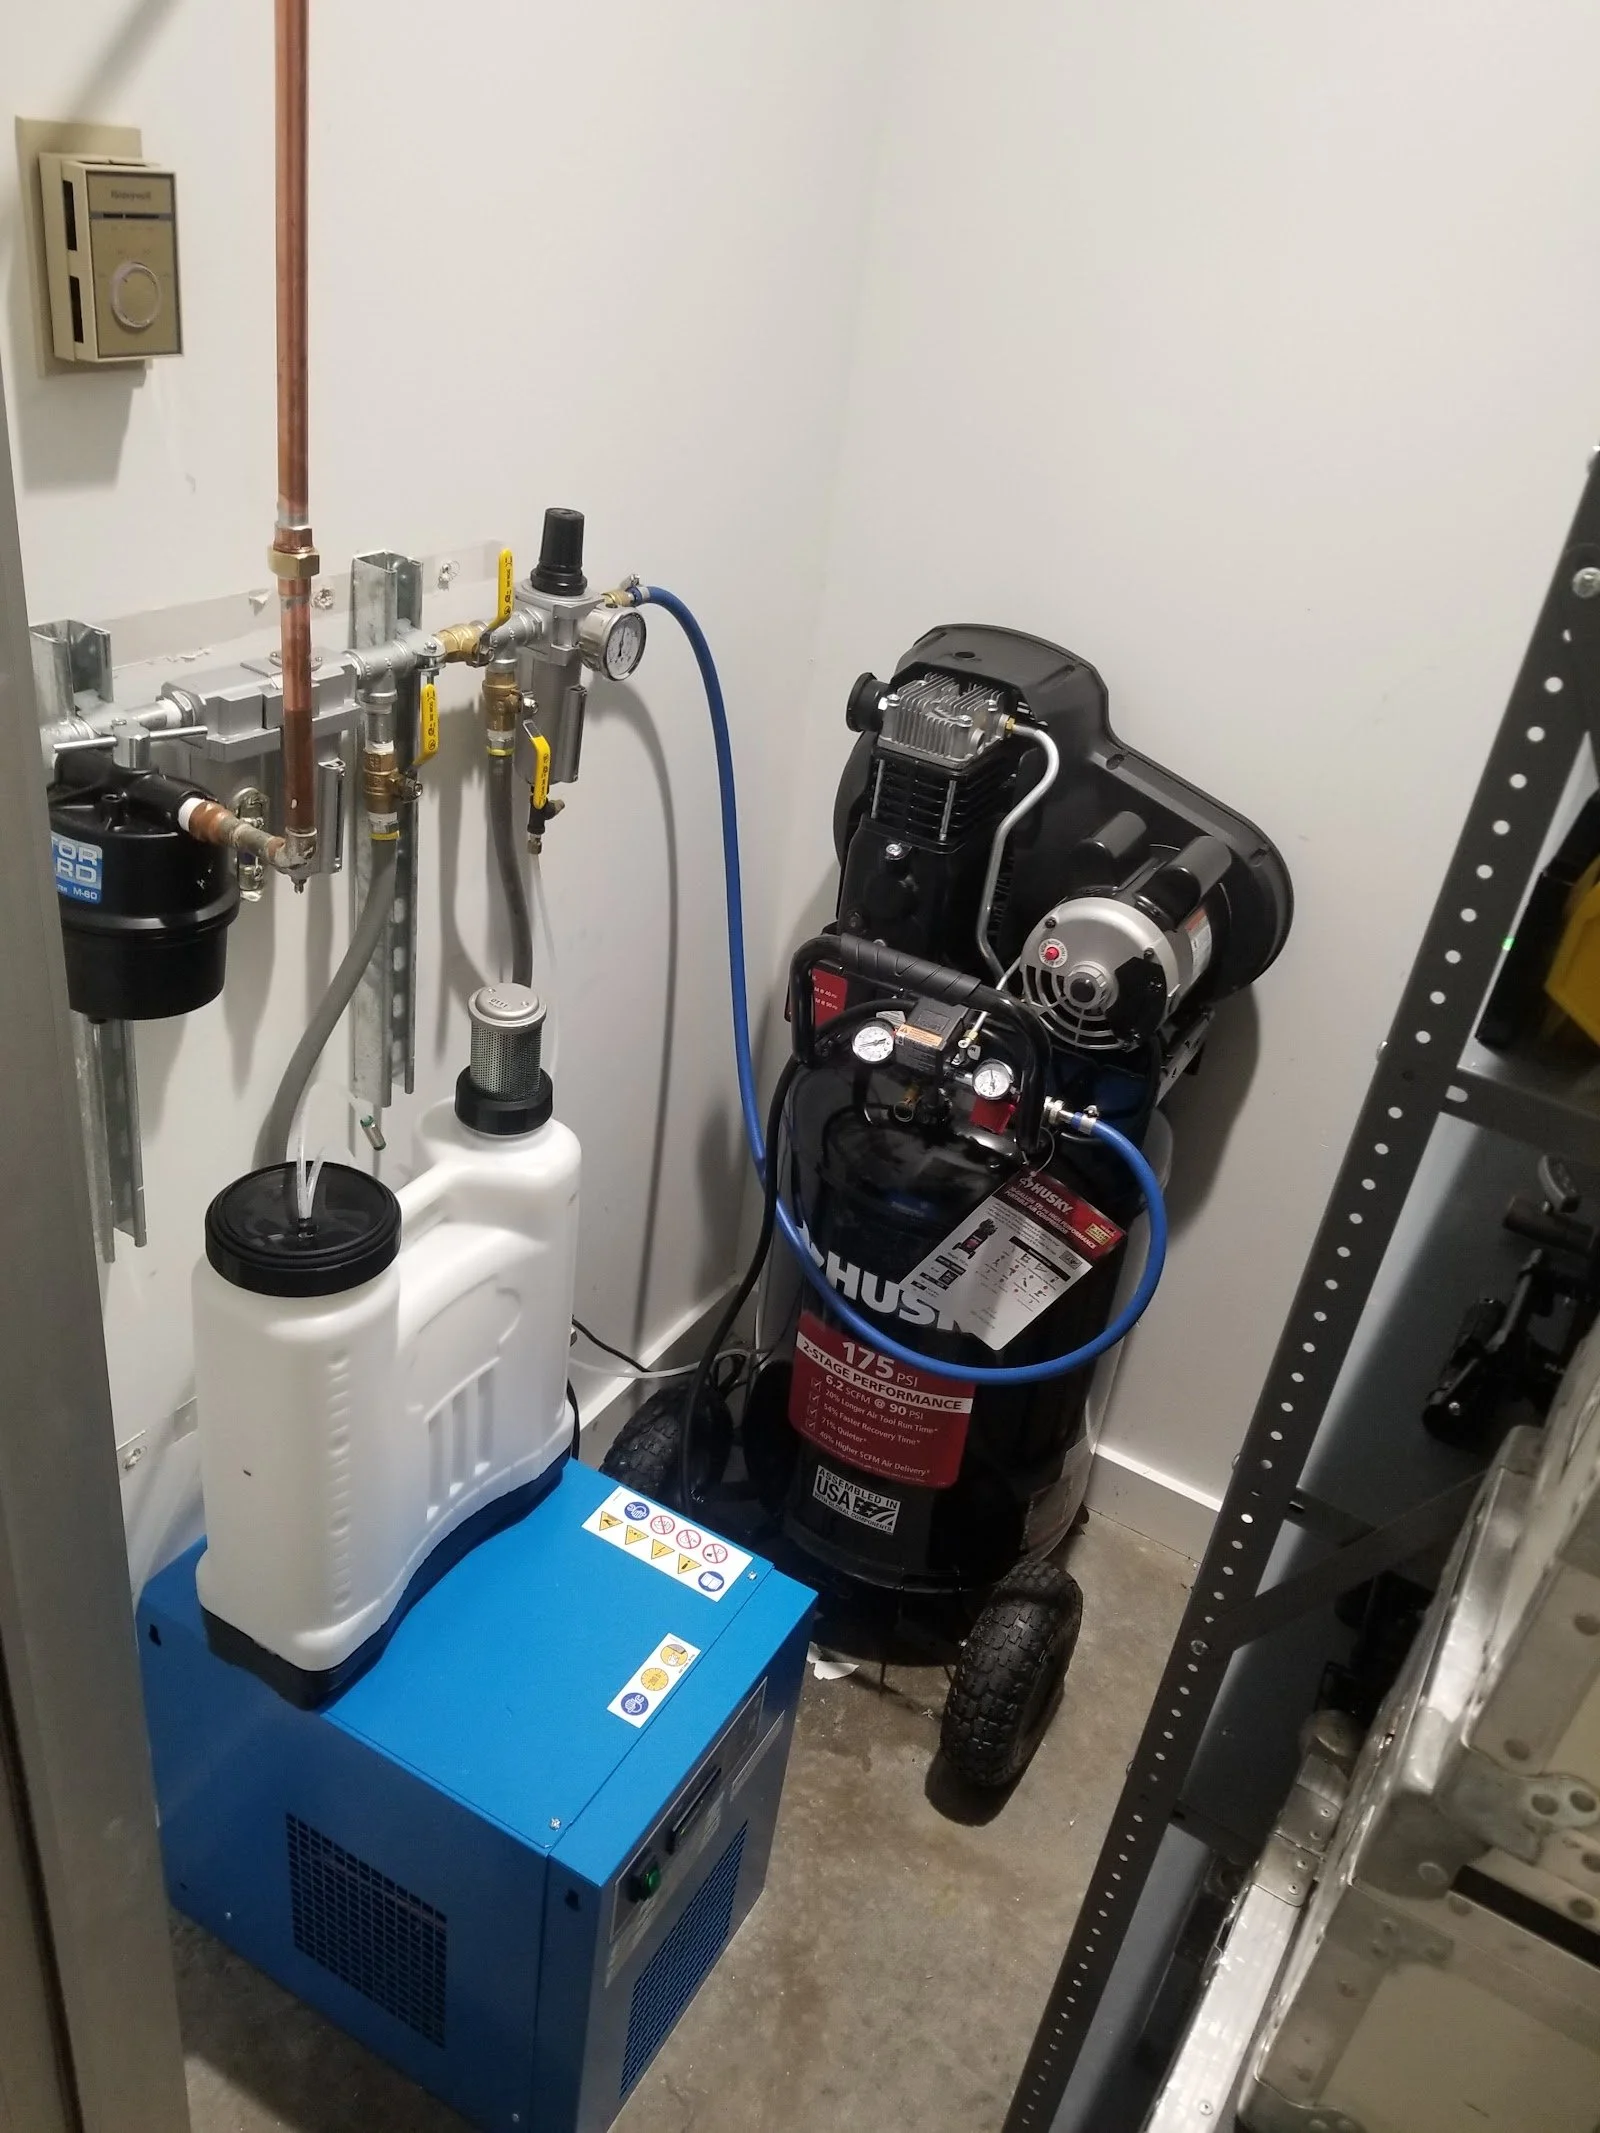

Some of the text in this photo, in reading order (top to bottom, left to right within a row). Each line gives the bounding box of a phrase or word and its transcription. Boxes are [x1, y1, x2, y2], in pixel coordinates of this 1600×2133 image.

[1030, 1182, 1073, 1213] HUSKY
[803, 1341, 962, 1410] 2-STAGE PERFORMANCE
[842, 1342, 918, 1387] 175 PSI
[826, 1375, 844, 1391] 6.2
[845, 1387, 871, 1404] SCFM
[889, 1404, 907, 1415] 90
[909, 1411, 923, 1420] PSI
[841, 1398, 865, 1414] Longer
[866, 1410, 878, 1419] Air
[880, 1415, 896, 1425] Tool
[897, 1421, 913, 1430] Run
[840, 1412, 861, 1427] Faster
[862, 1423, 896, 1441] Recovery
[835, 1440, 858, 1455] Higher
[860, 1451, 880, 1464] SCFM
[881, 1460, 893, 1468] Air
[817, 1476, 851, 1511] USA
[819, 1469, 882, 1504] ASSEMBLED
[885, 1500, 898, 1509] IN
[851, 1512, 892, 1532] COMPONENTS
